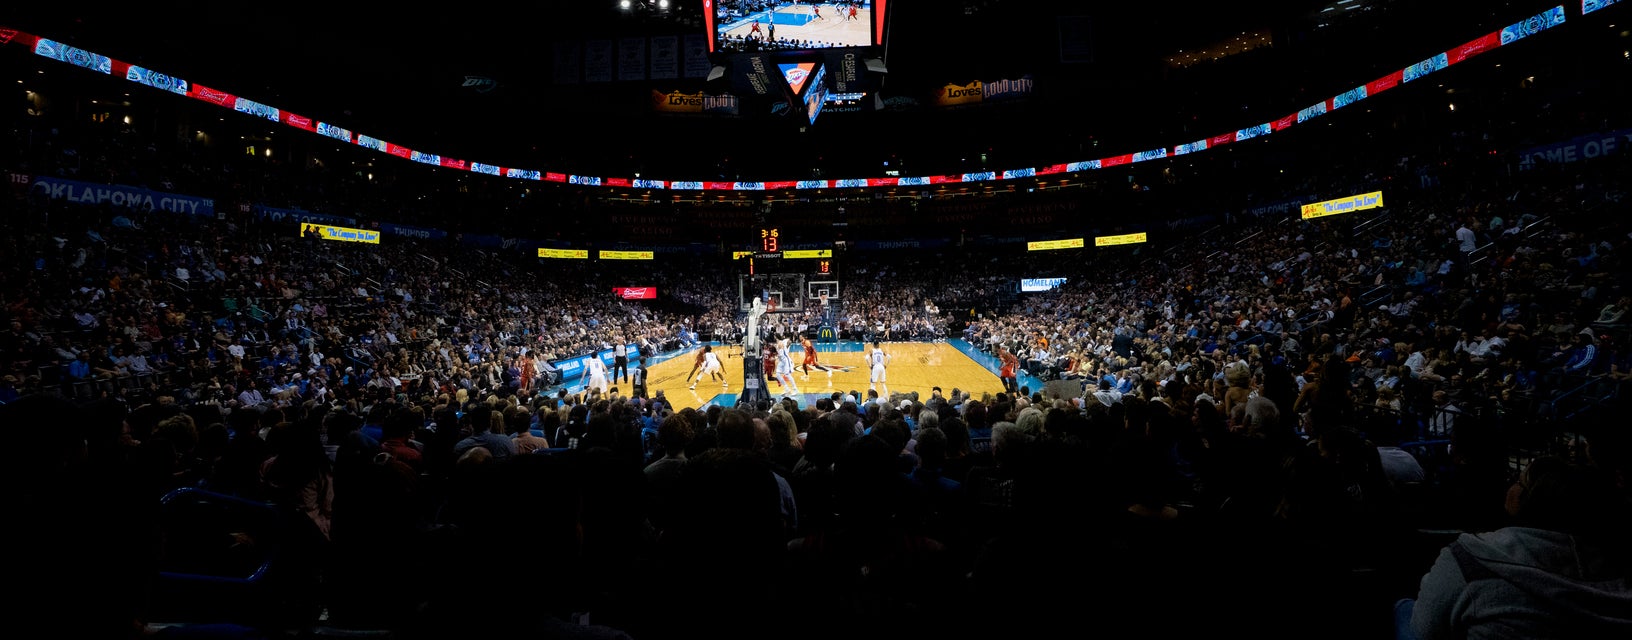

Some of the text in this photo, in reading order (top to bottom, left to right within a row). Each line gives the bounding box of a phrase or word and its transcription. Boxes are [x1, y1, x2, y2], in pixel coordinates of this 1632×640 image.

[1584, 136, 1616, 159] OF
[10, 173, 29, 184] 115
[33, 180, 201, 215] OKLAHOMA CITY
[761, 229, 778, 238] 3:16
[764, 237, 777, 252] 13
